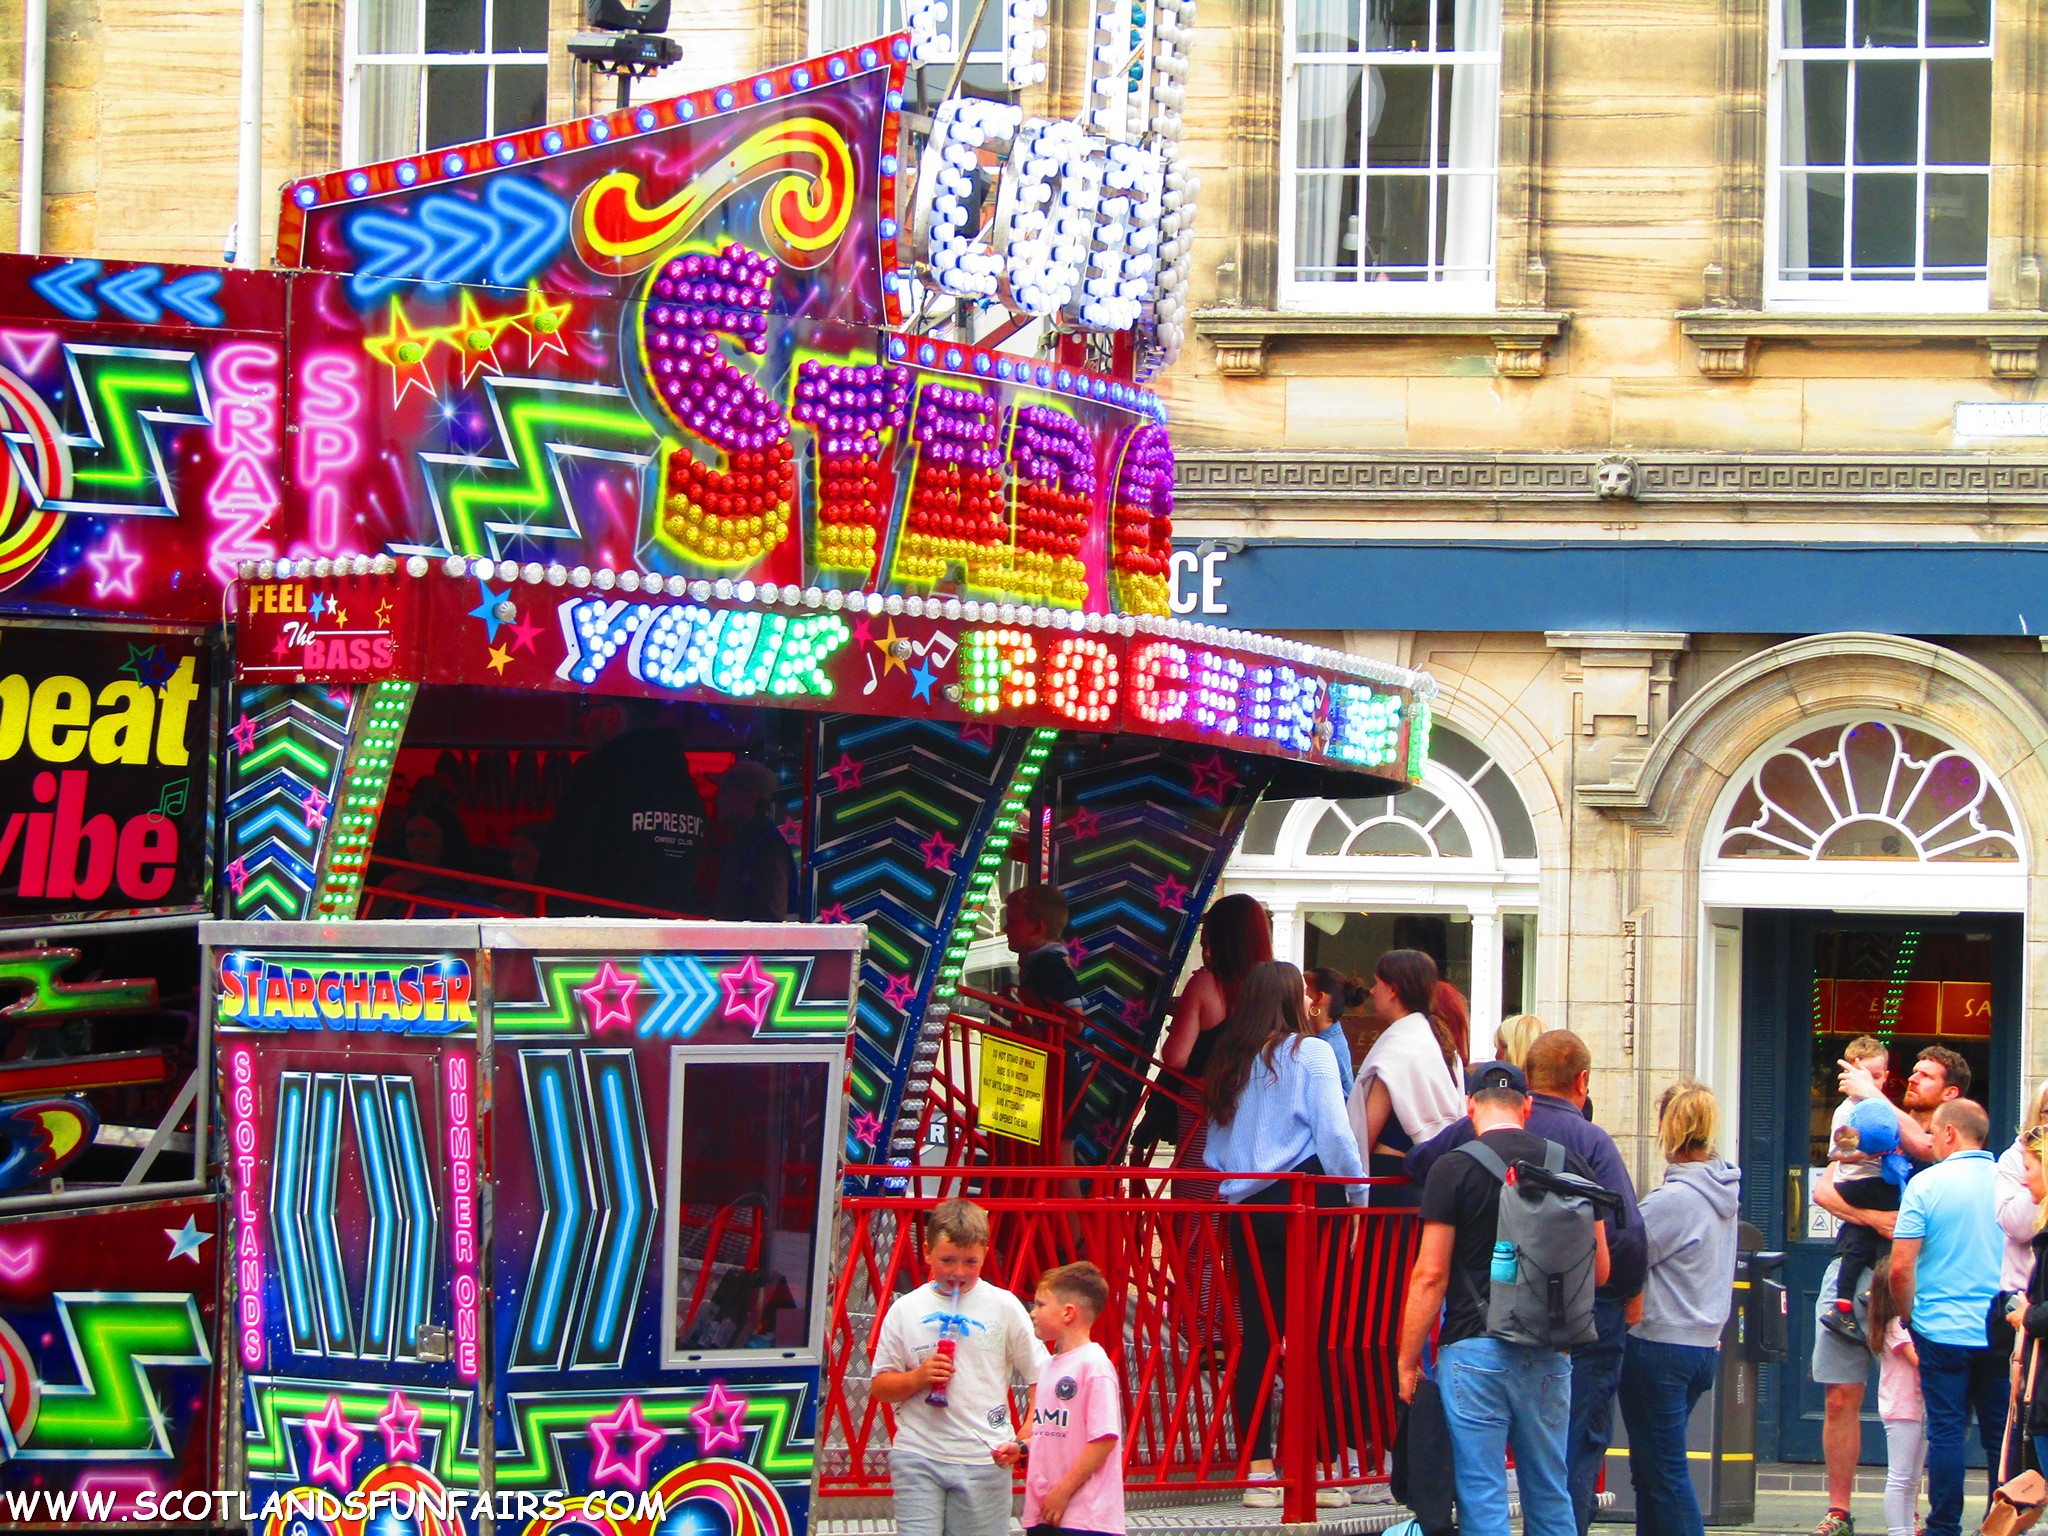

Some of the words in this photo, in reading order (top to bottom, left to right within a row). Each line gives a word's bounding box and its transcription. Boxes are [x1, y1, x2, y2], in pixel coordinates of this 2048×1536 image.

[301, 353, 361, 558] SPI
[251, 584, 307, 613] FEEL
[283, 621, 316, 648] The
[556, 597, 850, 696] YOUR
[304, 637, 393, 670] BASS
[220, 952, 472, 1030] STARCHASER
[234, 1051, 262, 1362] SCOTLANDS
[449, 1057, 473, 1263] NUMBER
[456, 1275, 477, 1376] ONE
